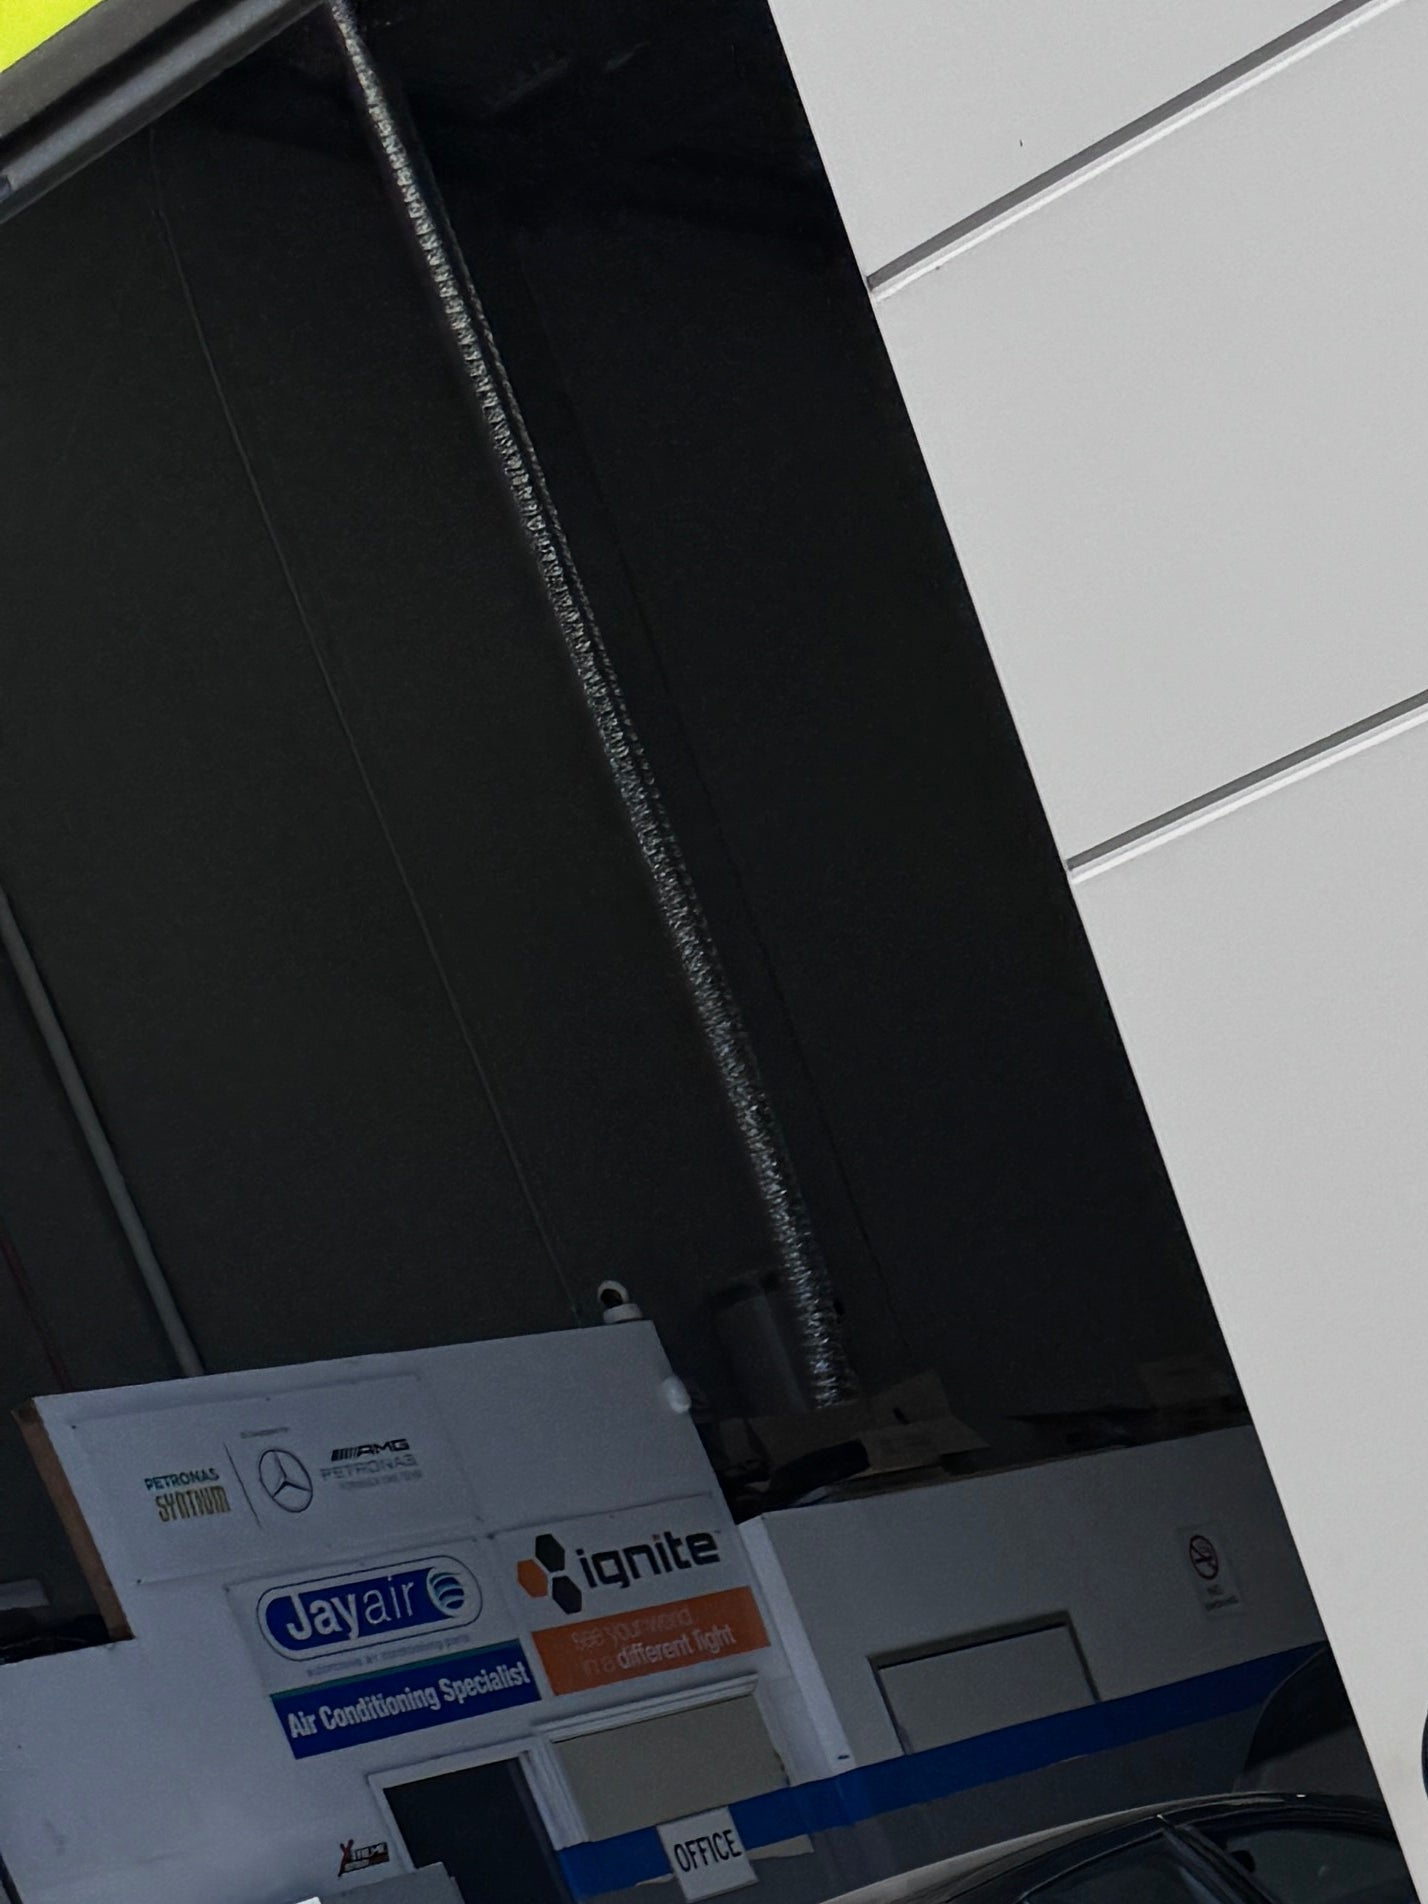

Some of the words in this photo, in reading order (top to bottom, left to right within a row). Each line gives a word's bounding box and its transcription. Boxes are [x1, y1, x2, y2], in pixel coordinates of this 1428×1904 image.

[355, 1438, 410, 1459] AMG
[144, 1467, 220, 1491] PETRONAS
[576, 1531, 721, 1589] ignite
[285, 1576, 415, 1641] Jayair
[616, 1636, 695, 1671] different
[692, 1623, 738, 1655] light
[286, 1711, 320, 1740] Air
[319, 1685, 442, 1732] Conditioning
[438, 1660, 532, 1705] Specialist
[674, 1829, 742, 1873] OFFICE
